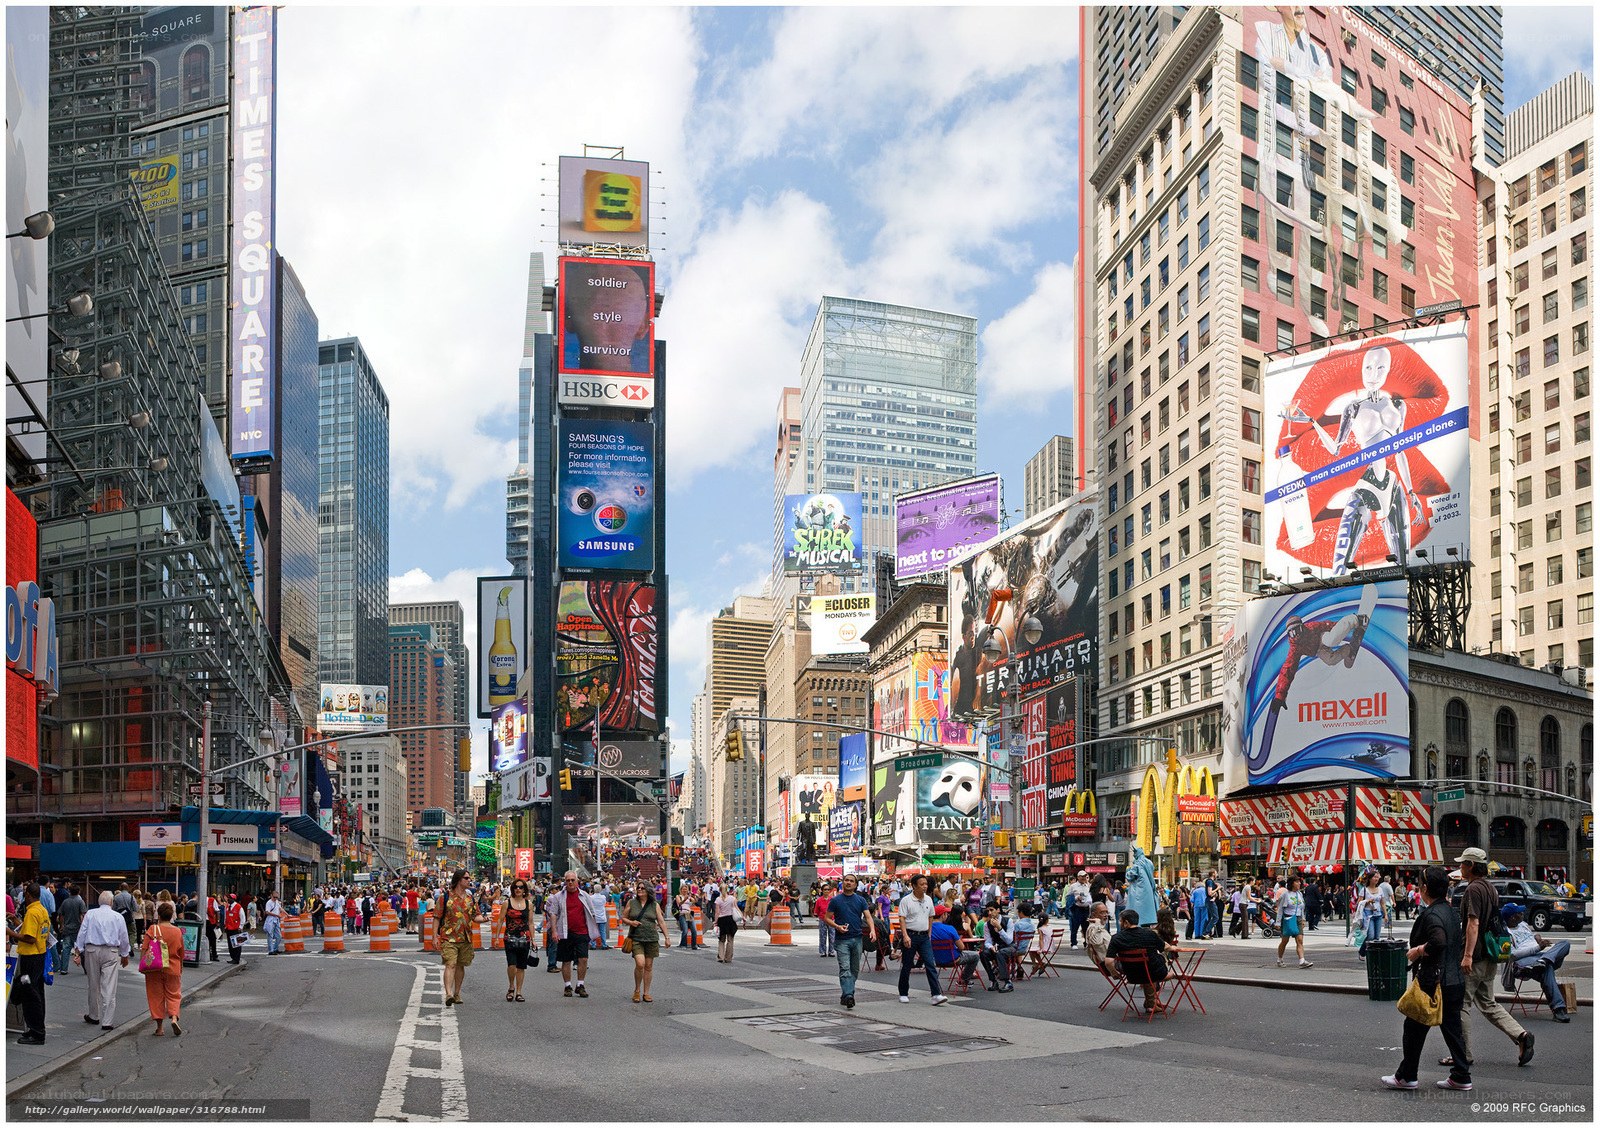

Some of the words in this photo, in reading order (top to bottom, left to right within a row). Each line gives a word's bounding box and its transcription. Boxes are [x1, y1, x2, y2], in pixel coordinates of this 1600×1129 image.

[152, 14, 202, 36] SQUARE
[1342, 8, 1406, 65] Colombian
[1407, 60, 1444, 96] Coffee
[238, 32, 268, 192] TIMES
[1424, 224, 1462, 300] Juan
[588, 277, 628, 289] soldier
[238, 210, 269, 408] SQUARE
[593, 312, 622, 323] style
[583, 344, 631, 356] survivor
[564, 382, 618, 399] HSBC
[241, 429, 262, 440] NYC
[568, 434, 624, 444] SAMSUNG'S
[604, 454, 646, 462] information
[1278, 477, 1306, 497] SVEDKA
[1310, 470, 1329, 482] man
[1330, 458, 1360, 474] cannot
[1361, 450, 1377, 462] live
[1379, 444, 1391, 454] on
[1393, 431, 1423, 450] gossip
[1425, 419, 1457, 436] alone.
[1284, 493, 1305, 504] VODKA
[1430, 495, 1451, 505] voted
[1452, 492, 1460, 500] #1
[1436, 502, 1458, 513] vodka
[1434, 514, 1442, 524] of
[1442, 511, 1462, 522] 2033.
[578, 541, 634, 551] SAMSUNG
[792, 528, 856, 552] SHREK
[796, 550, 856, 566] MUSICAL
[898, 550, 928, 567] next
[930, 548, 945, 561] to
[833, 598, 870, 610] CLOSER
[557, 622, 605, 631] Happiness
[567, 614, 593, 624] Open
[1047, 632, 1085, 650] WORTHINGTON
[976, 636, 1098, 687] TERINATO
[986, 653, 1090, 693] SAVATION
[1032, 678, 1051, 688] BACK
[1054, 671, 1075, 683] 05.21
[1298, 692, 1387, 723] maxell
[325, 712, 352, 722] HOTEL
[359, 715, 384, 723] DOGS
[1322, 719, 1387, 729] www.maxell.com
[1050, 730, 1074, 751] WAY'S
[900, 758, 935, 768] Broadway
[1050, 748, 1074, 765] SURE
[1051, 761, 1075, 783] THING
[211, 829, 225, 846] T
[519, 850, 530, 871] tkts
[750, 852, 760, 872] tkts
